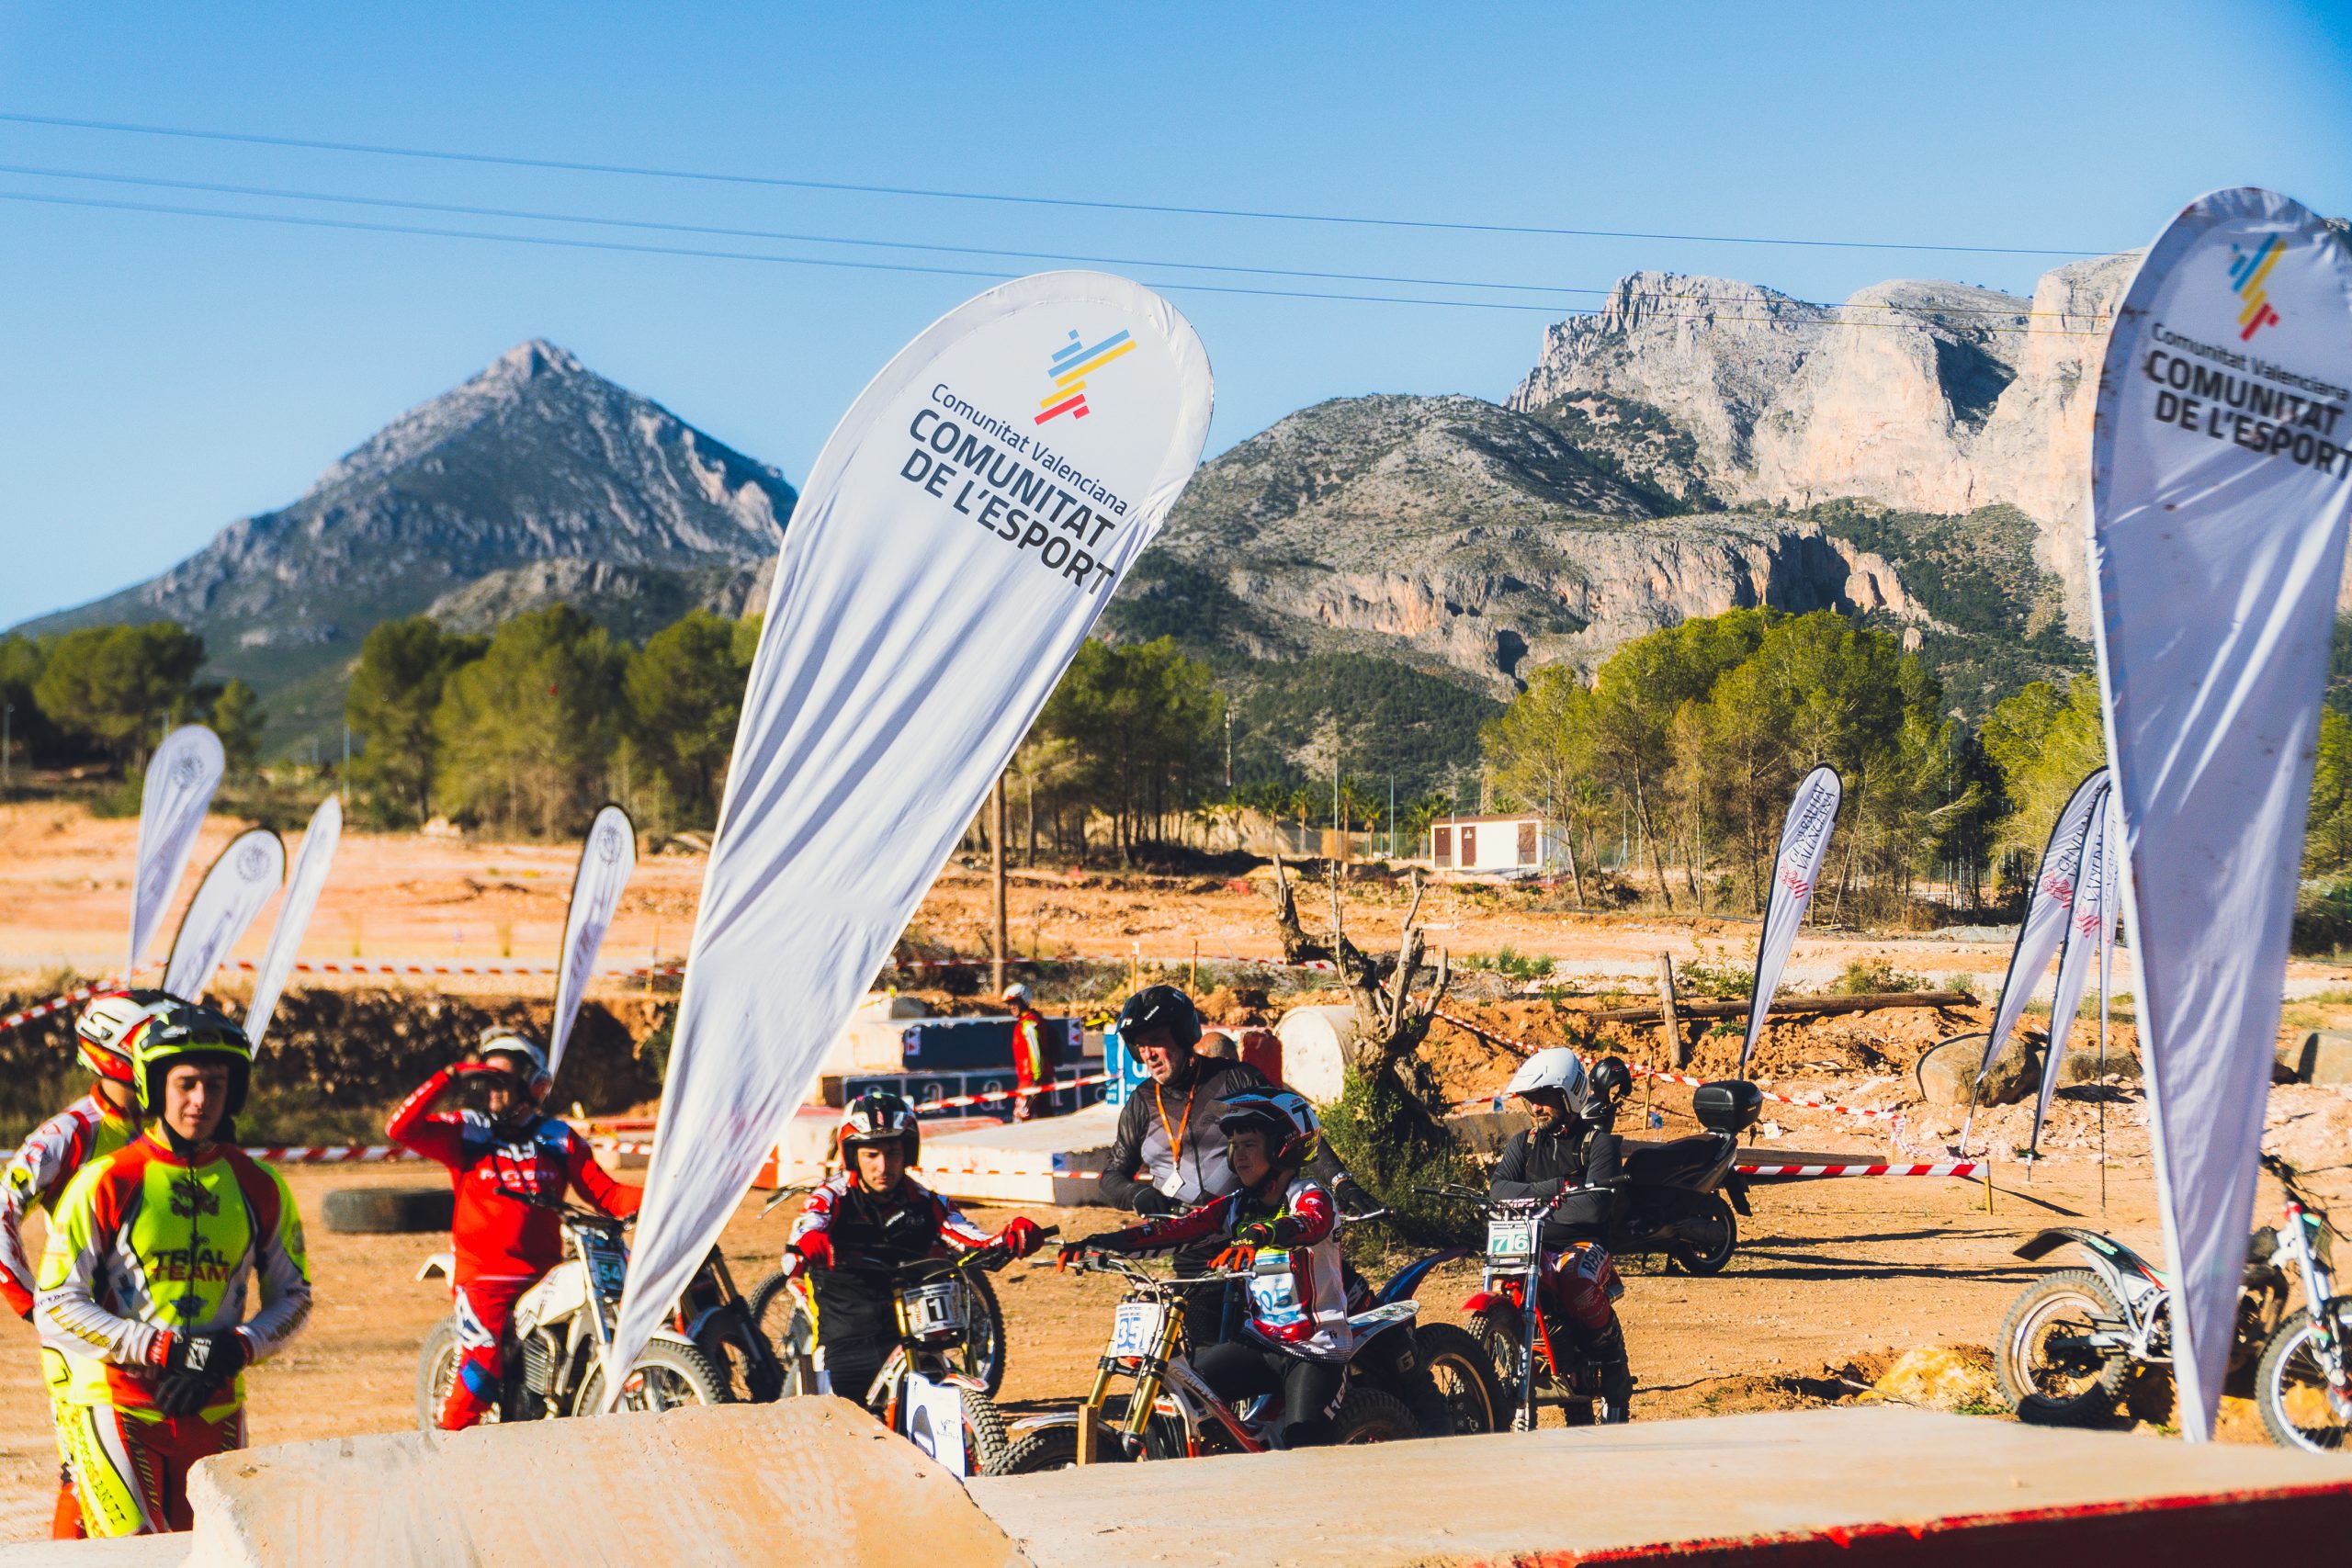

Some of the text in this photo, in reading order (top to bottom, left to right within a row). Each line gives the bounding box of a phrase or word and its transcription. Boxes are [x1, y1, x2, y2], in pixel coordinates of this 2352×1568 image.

[2149, 350, 2345, 436] COMUNITAT
[2151, 322, 2349, 400] Comunitat Valenciana
[932, 383, 1128, 516] Comunitat Valenciana
[2155, 390, 2352, 480] DE L'ESPORT
[900, 447, 1116, 595] DE L'ESPORT
[910, 409, 1116, 548] COMUNITAT
[600, 1263, 622, 1280] 54
[1493, 1234, 1530, 1253] 76
[928, 1297, 944, 1320] 1
